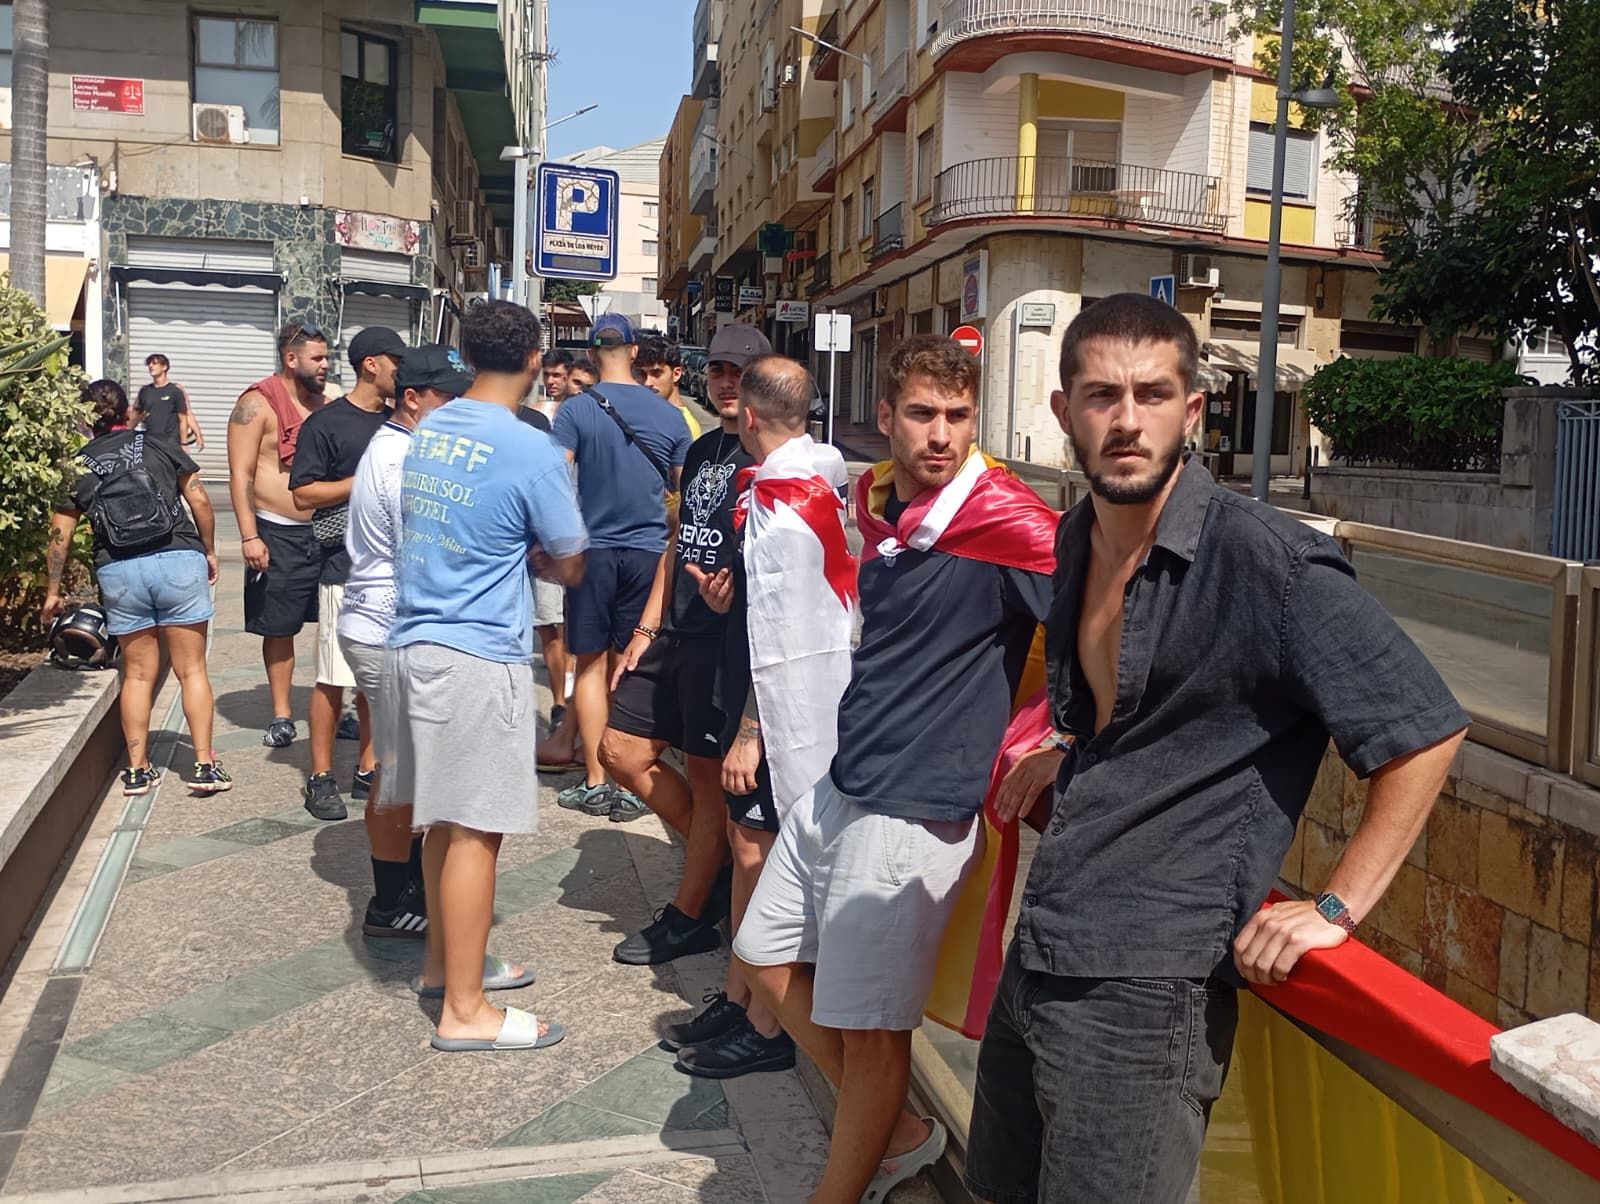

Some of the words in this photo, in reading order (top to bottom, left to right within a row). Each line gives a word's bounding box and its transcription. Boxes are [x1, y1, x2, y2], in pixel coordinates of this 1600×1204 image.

[549, 240, 566, 248] PLAZA
[567, 241, 574, 249] DE
[575, 242, 585, 250] LOS
[586, 243, 604, 251] REYES
[133, 433, 144, 465] GUESS
[676, 543, 717, 565] PARS
